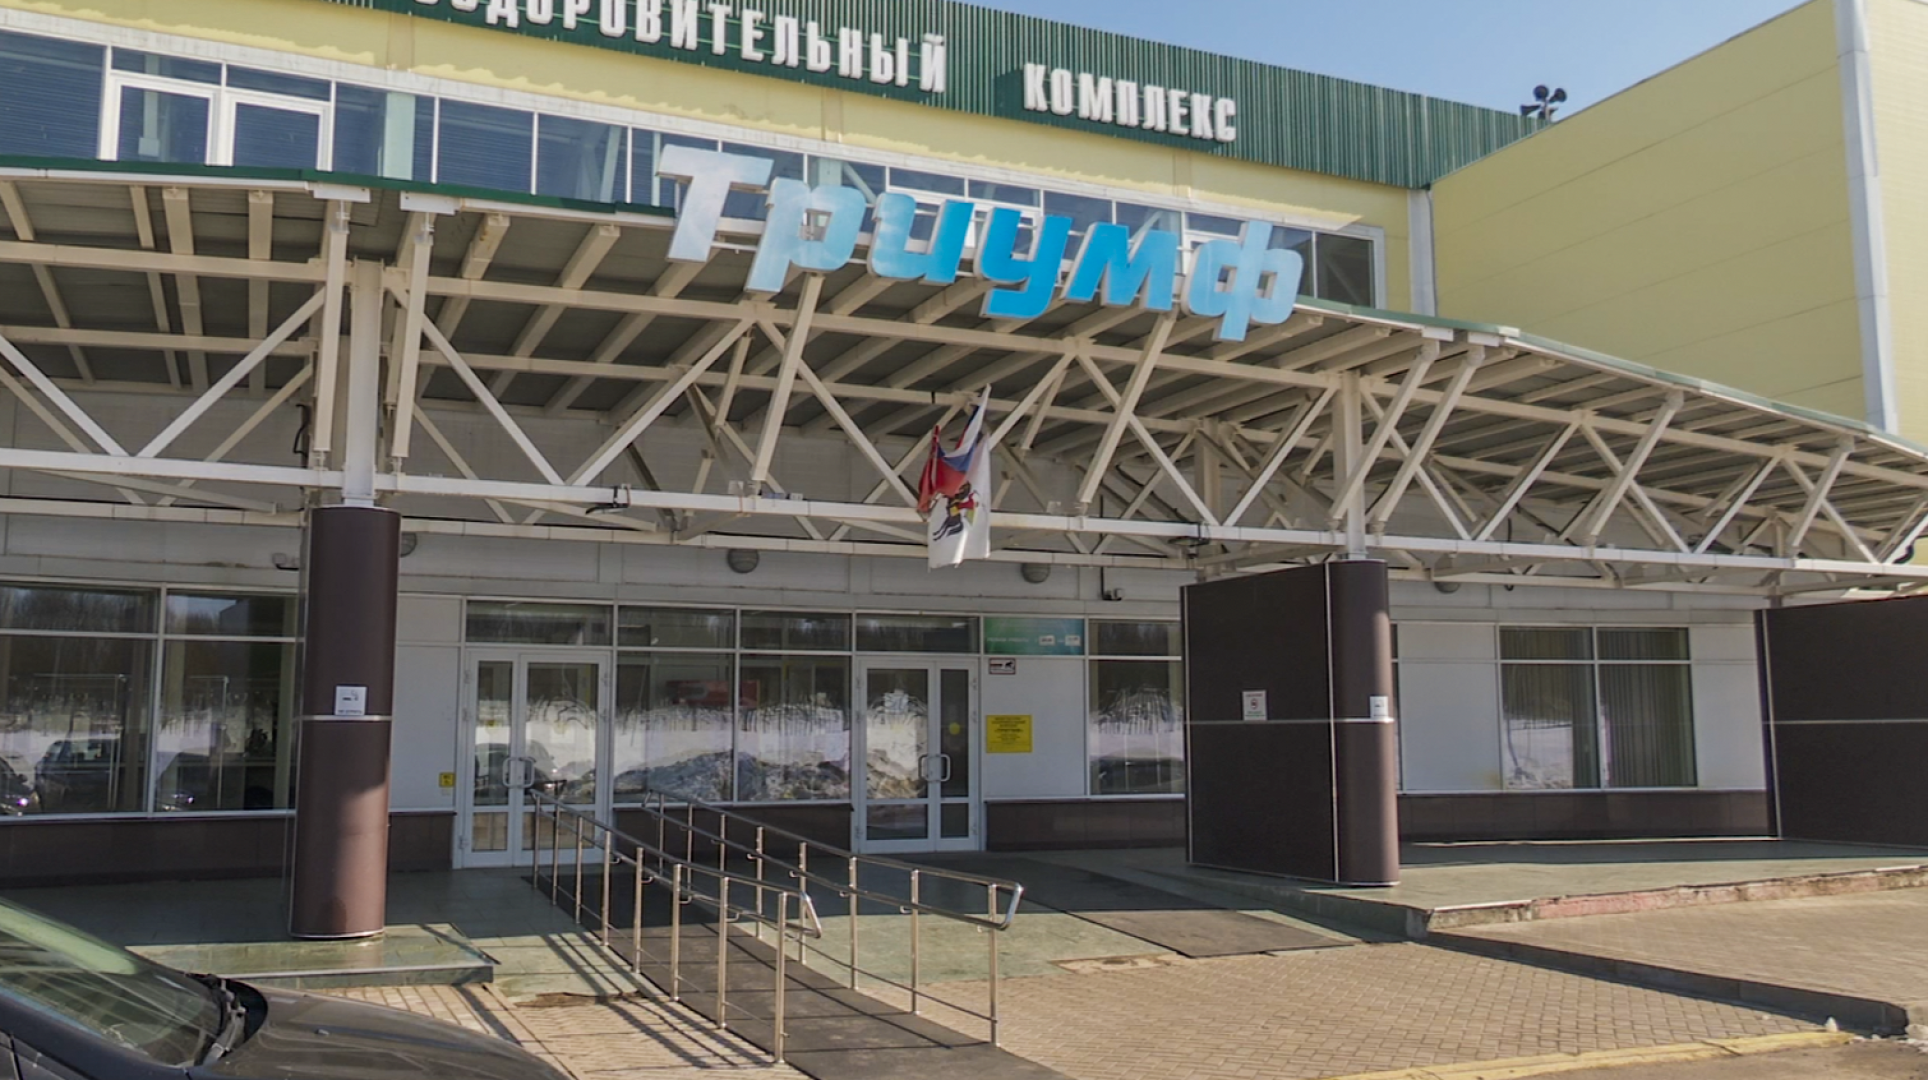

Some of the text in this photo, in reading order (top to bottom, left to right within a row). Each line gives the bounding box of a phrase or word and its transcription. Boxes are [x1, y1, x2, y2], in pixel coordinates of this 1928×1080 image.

[414, 0, 1236, 142] РОВИТЕЛЬНЫЙ КОМПЛЕКС
[657, 144, 1302, 342] Триумф
